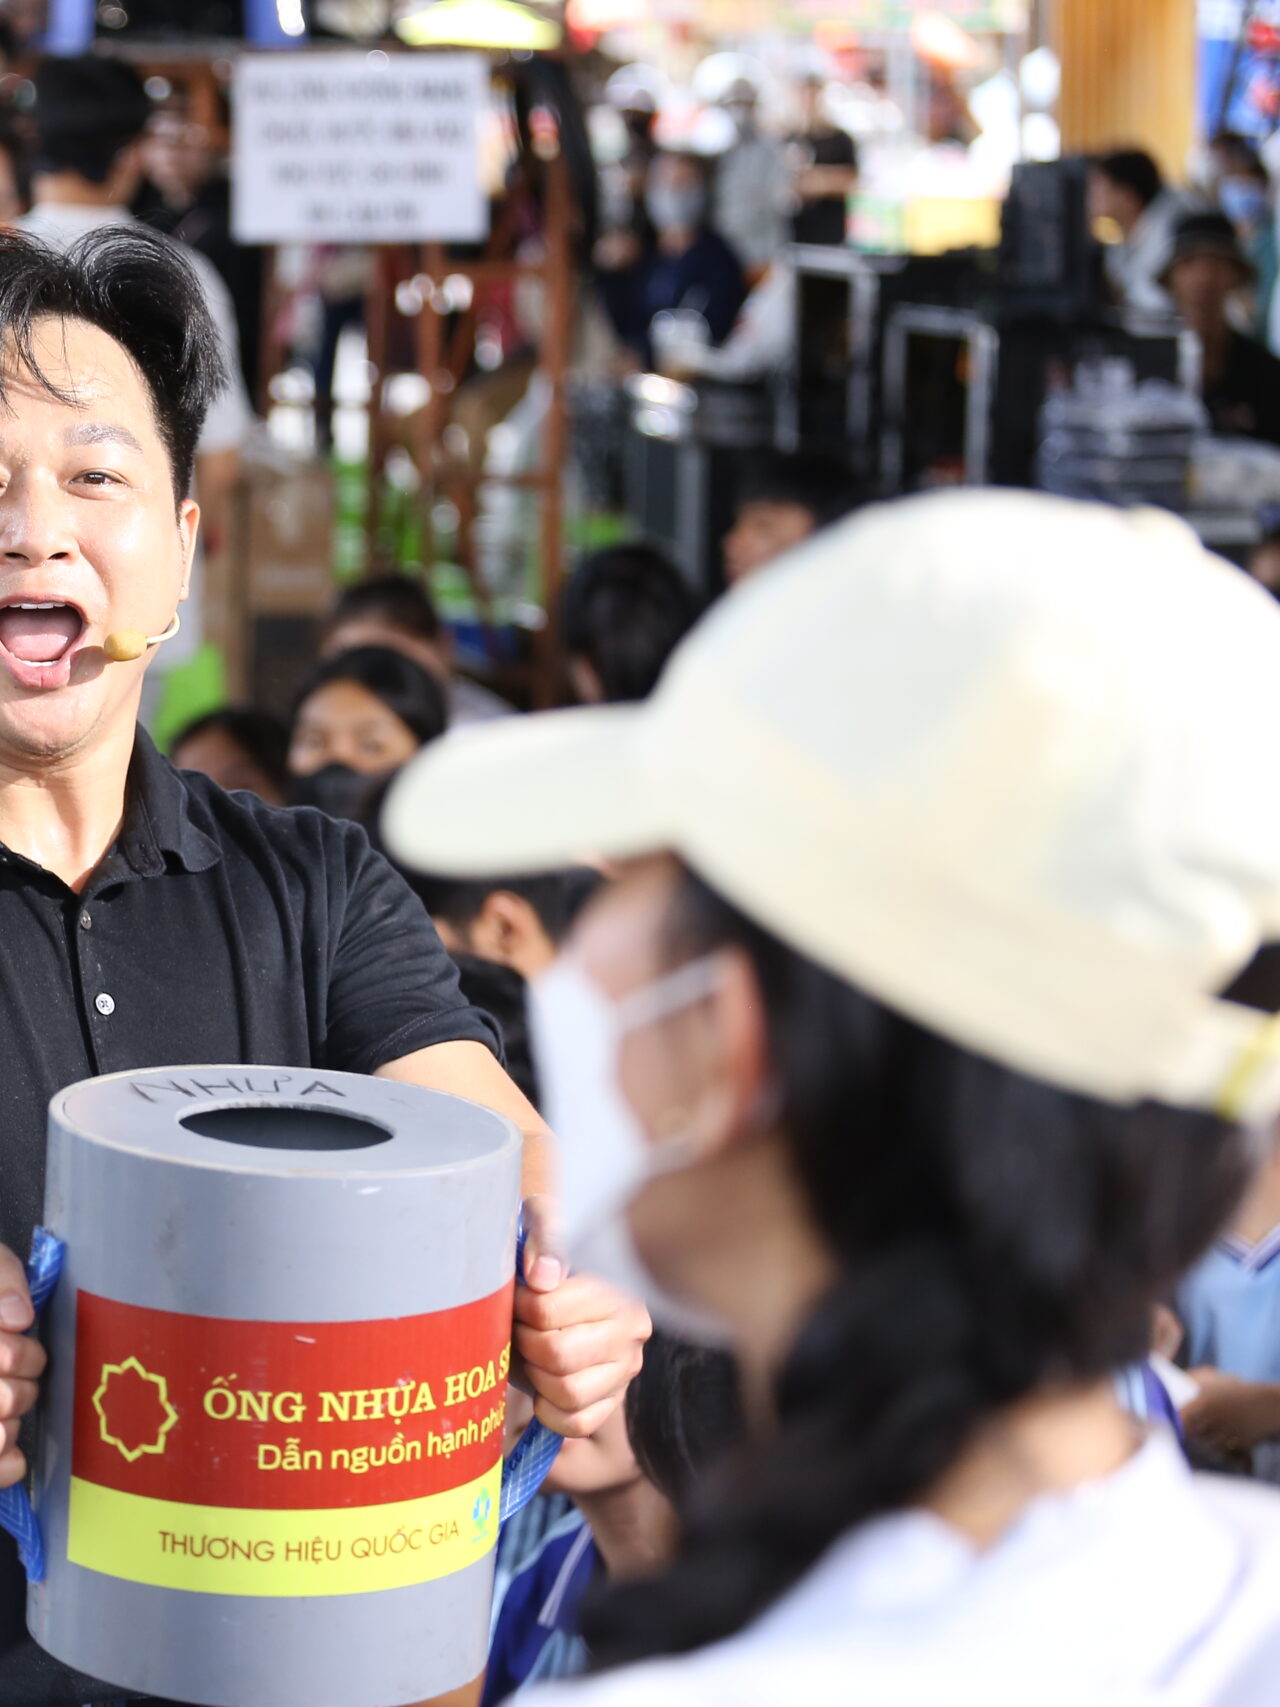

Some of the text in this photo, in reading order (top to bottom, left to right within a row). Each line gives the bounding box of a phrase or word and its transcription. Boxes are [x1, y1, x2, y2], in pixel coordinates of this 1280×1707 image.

[203, 1372, 307, 1423] ỐNG
[317, 1380, 437, 1424] NHỰA
[443, 1360, 497, 1407] HOA
[257, 1437, 322, 1471] Dẫn
[330, 1432, 422, 1474] nguồn
[427, 1418, 479, 1459] hạnh
[158, 1530, 275, 1563] THƯƠNG
[285, 1536, 342, 1566] HIỆU
[350, 1525, 422, 1560] QUỐC
[428, 1518, 460, 1547] GIA
